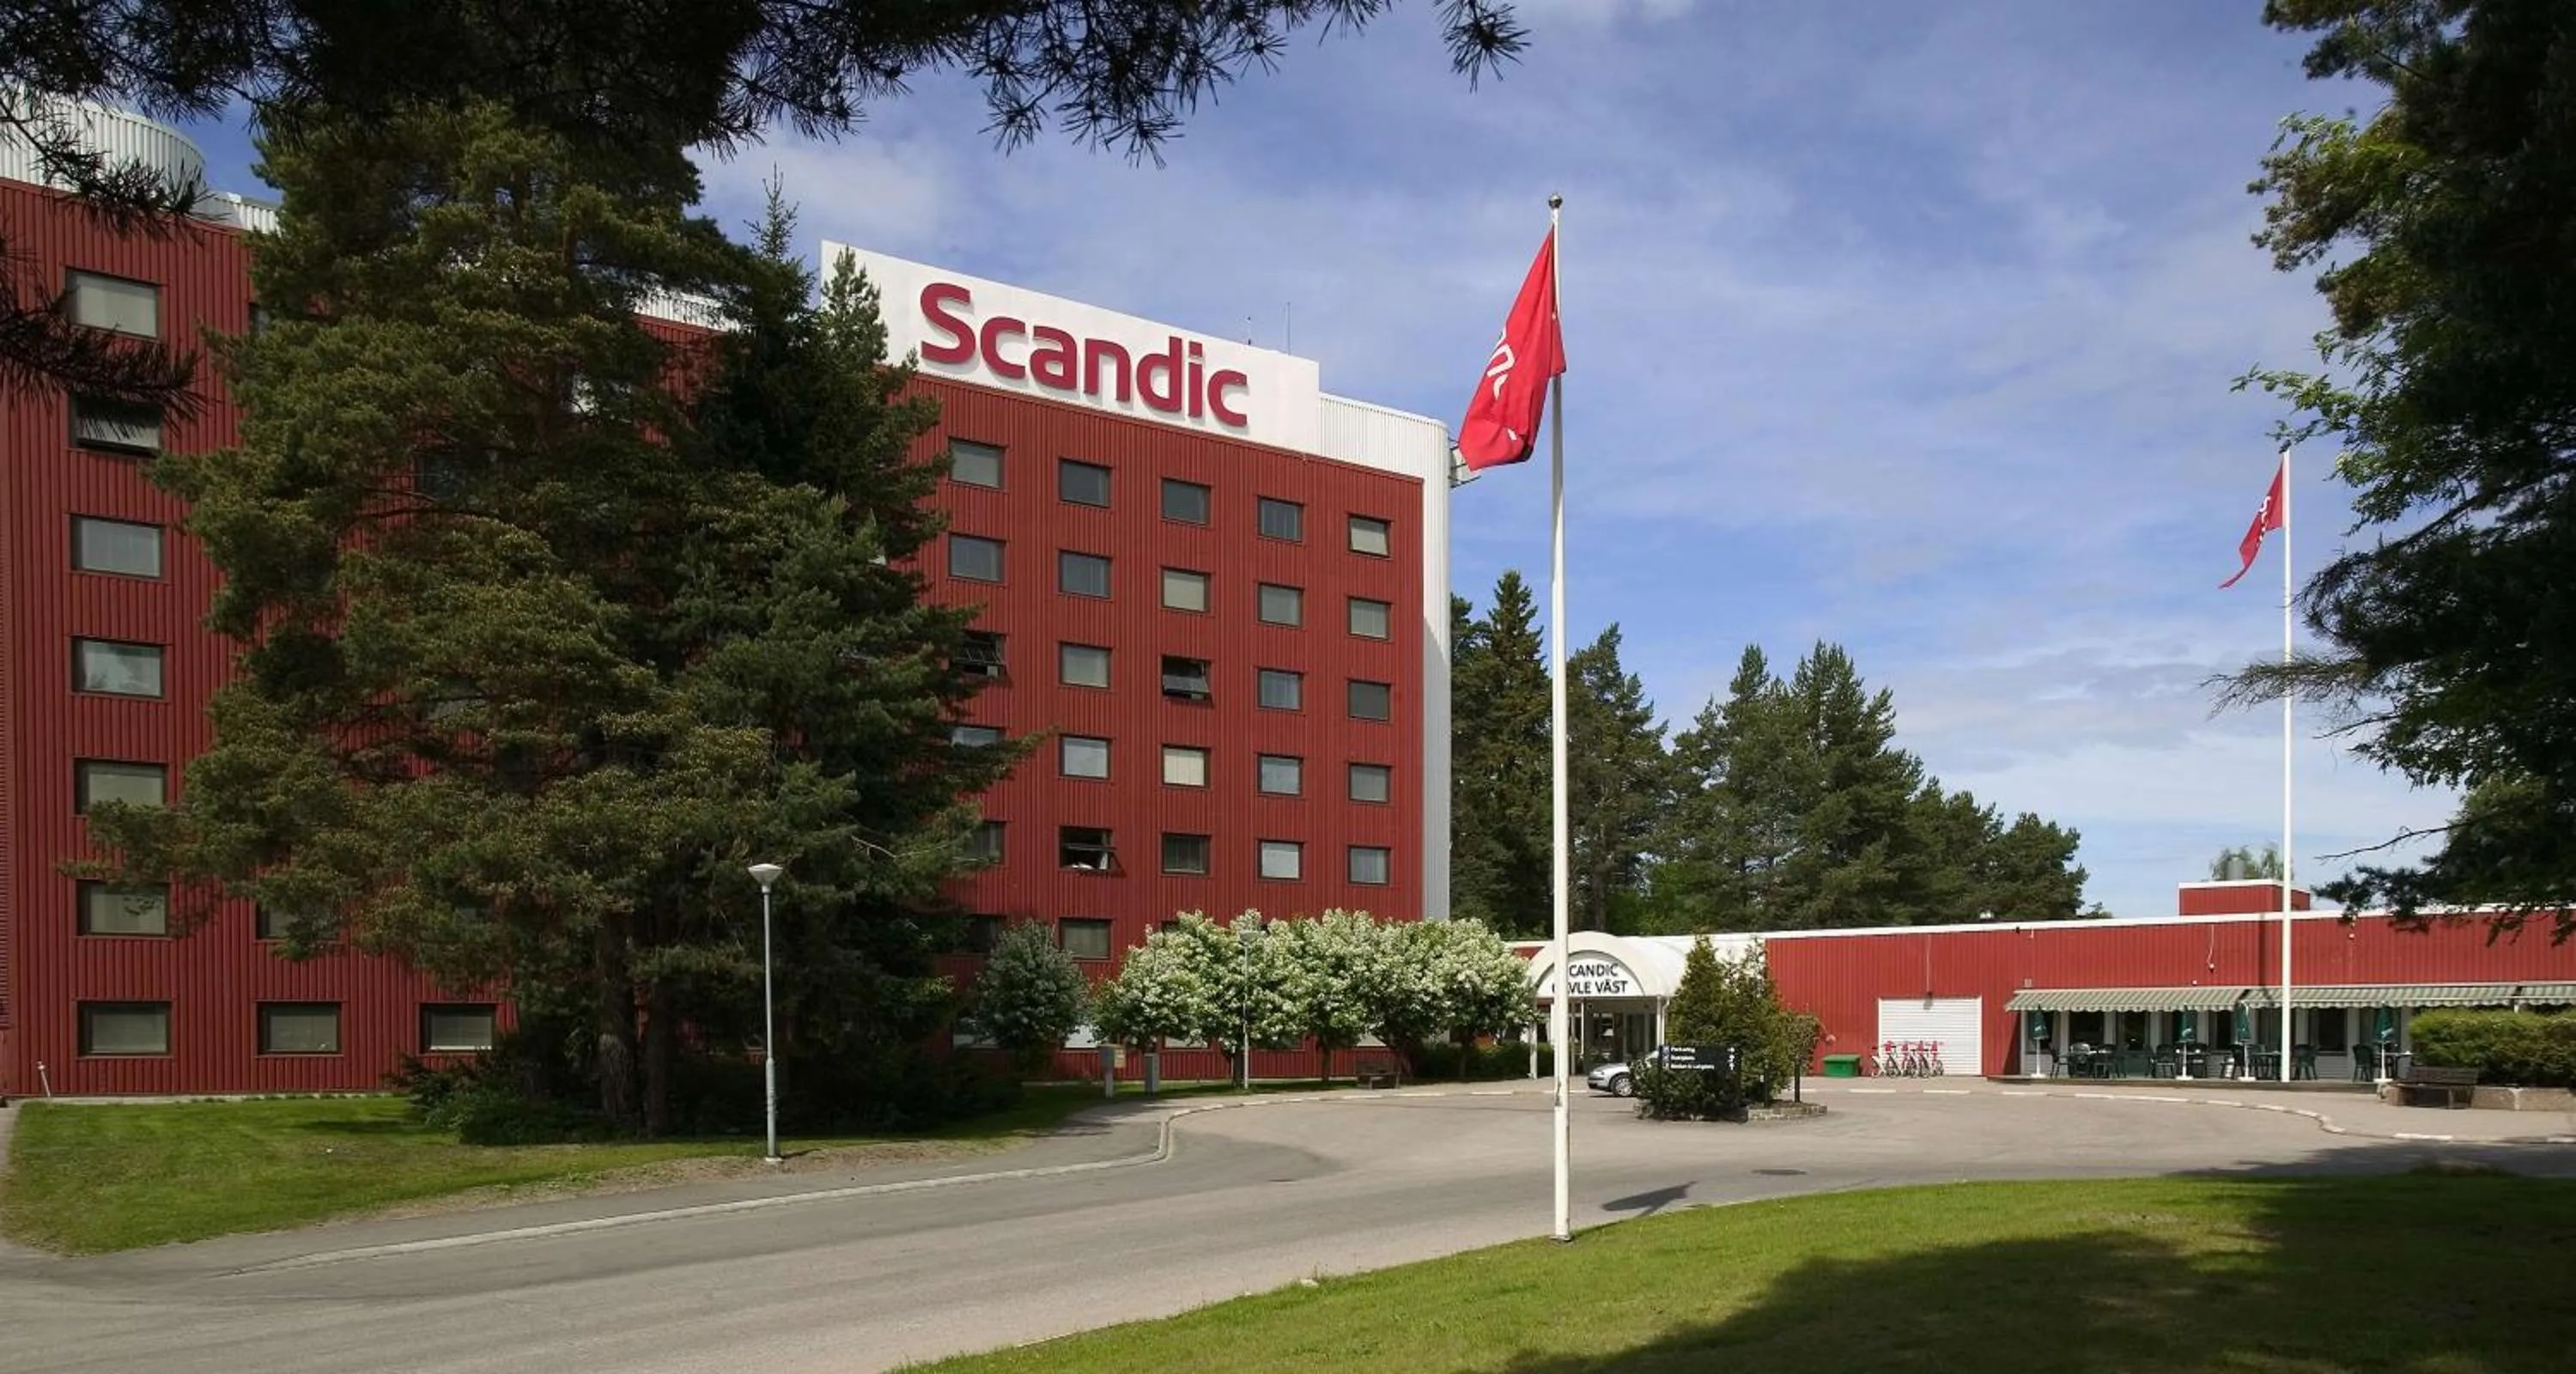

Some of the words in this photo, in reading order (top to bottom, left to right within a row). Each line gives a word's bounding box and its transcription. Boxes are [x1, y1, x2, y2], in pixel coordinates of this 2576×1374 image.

[920, 283, 1248, 428] Scandic
[1568, 963, 1619, 977] CANDIC
[1551, 981, 1592, 994] VLE
[1595, 978, 1629, 994] VÄST
